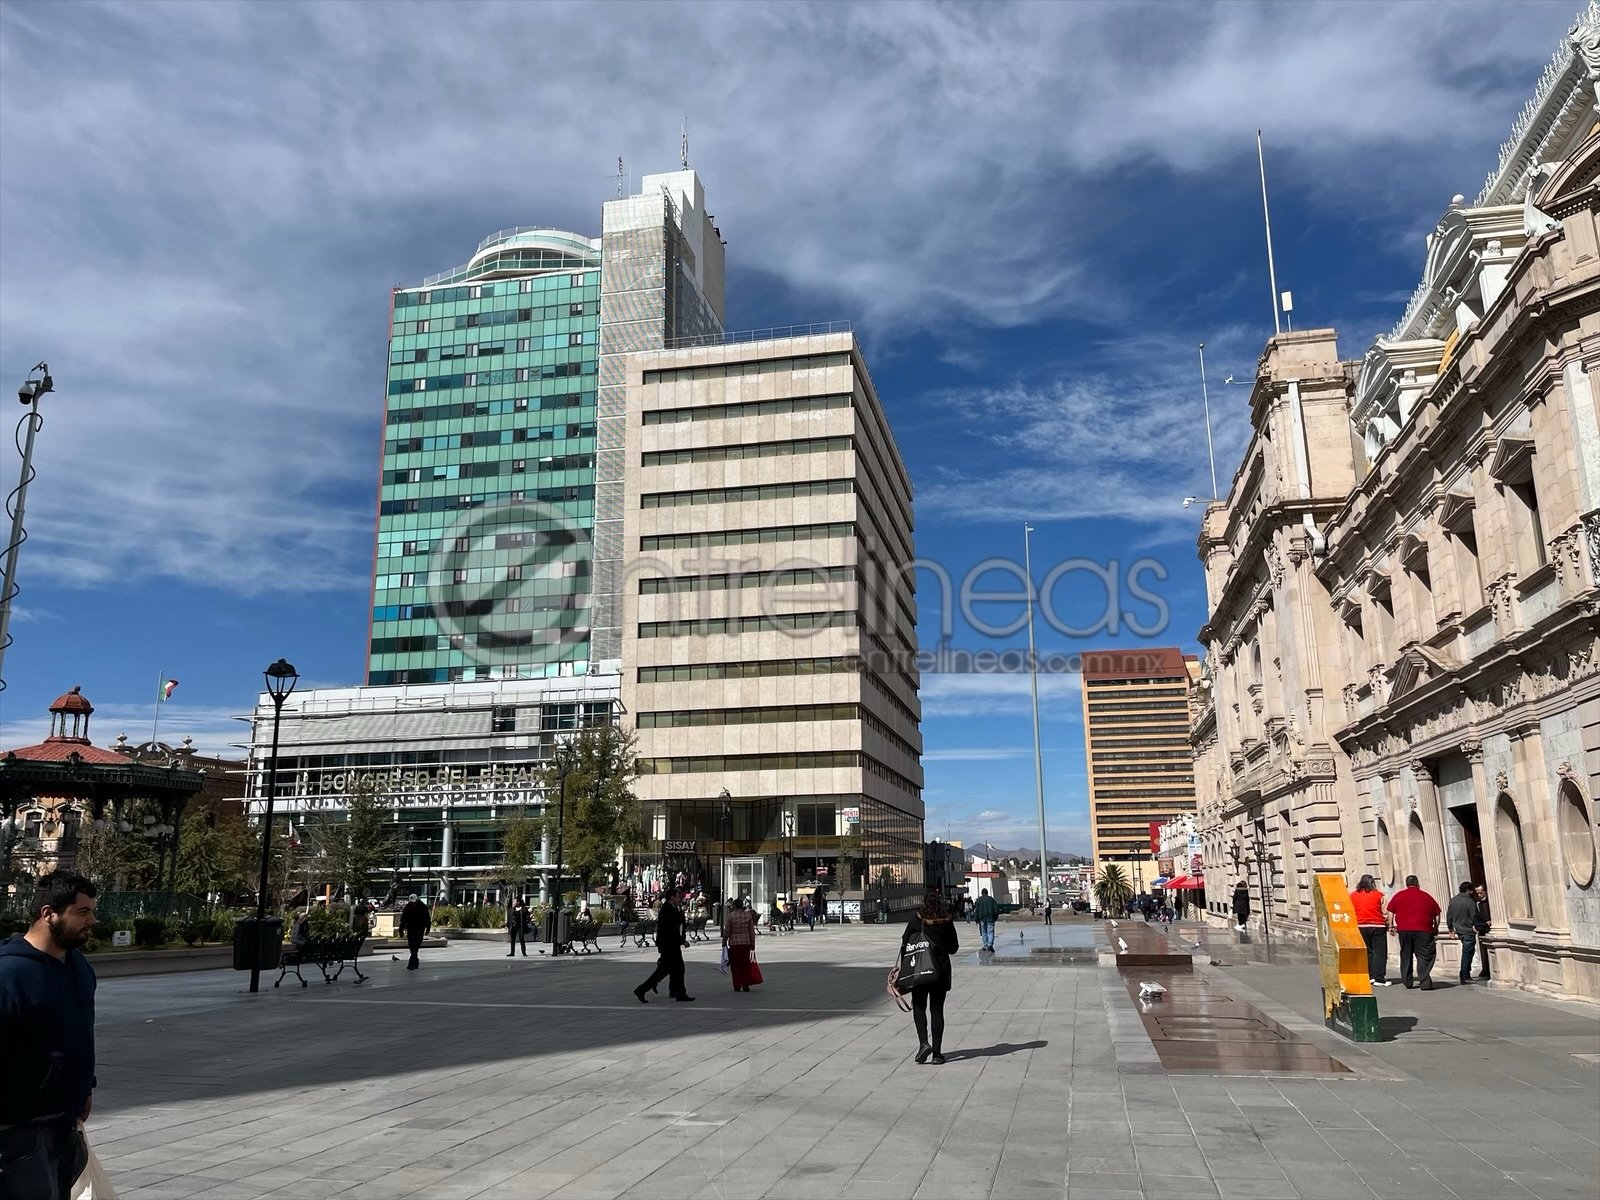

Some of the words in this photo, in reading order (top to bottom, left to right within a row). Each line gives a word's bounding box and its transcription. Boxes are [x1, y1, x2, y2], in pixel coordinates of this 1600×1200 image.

[320, 769, 431, 792] CONGRESO
[436, 768, 471, 787] DEL
[479, 765, 557, 786] ESTAD
[665, 840, 696, 850] SISAY
